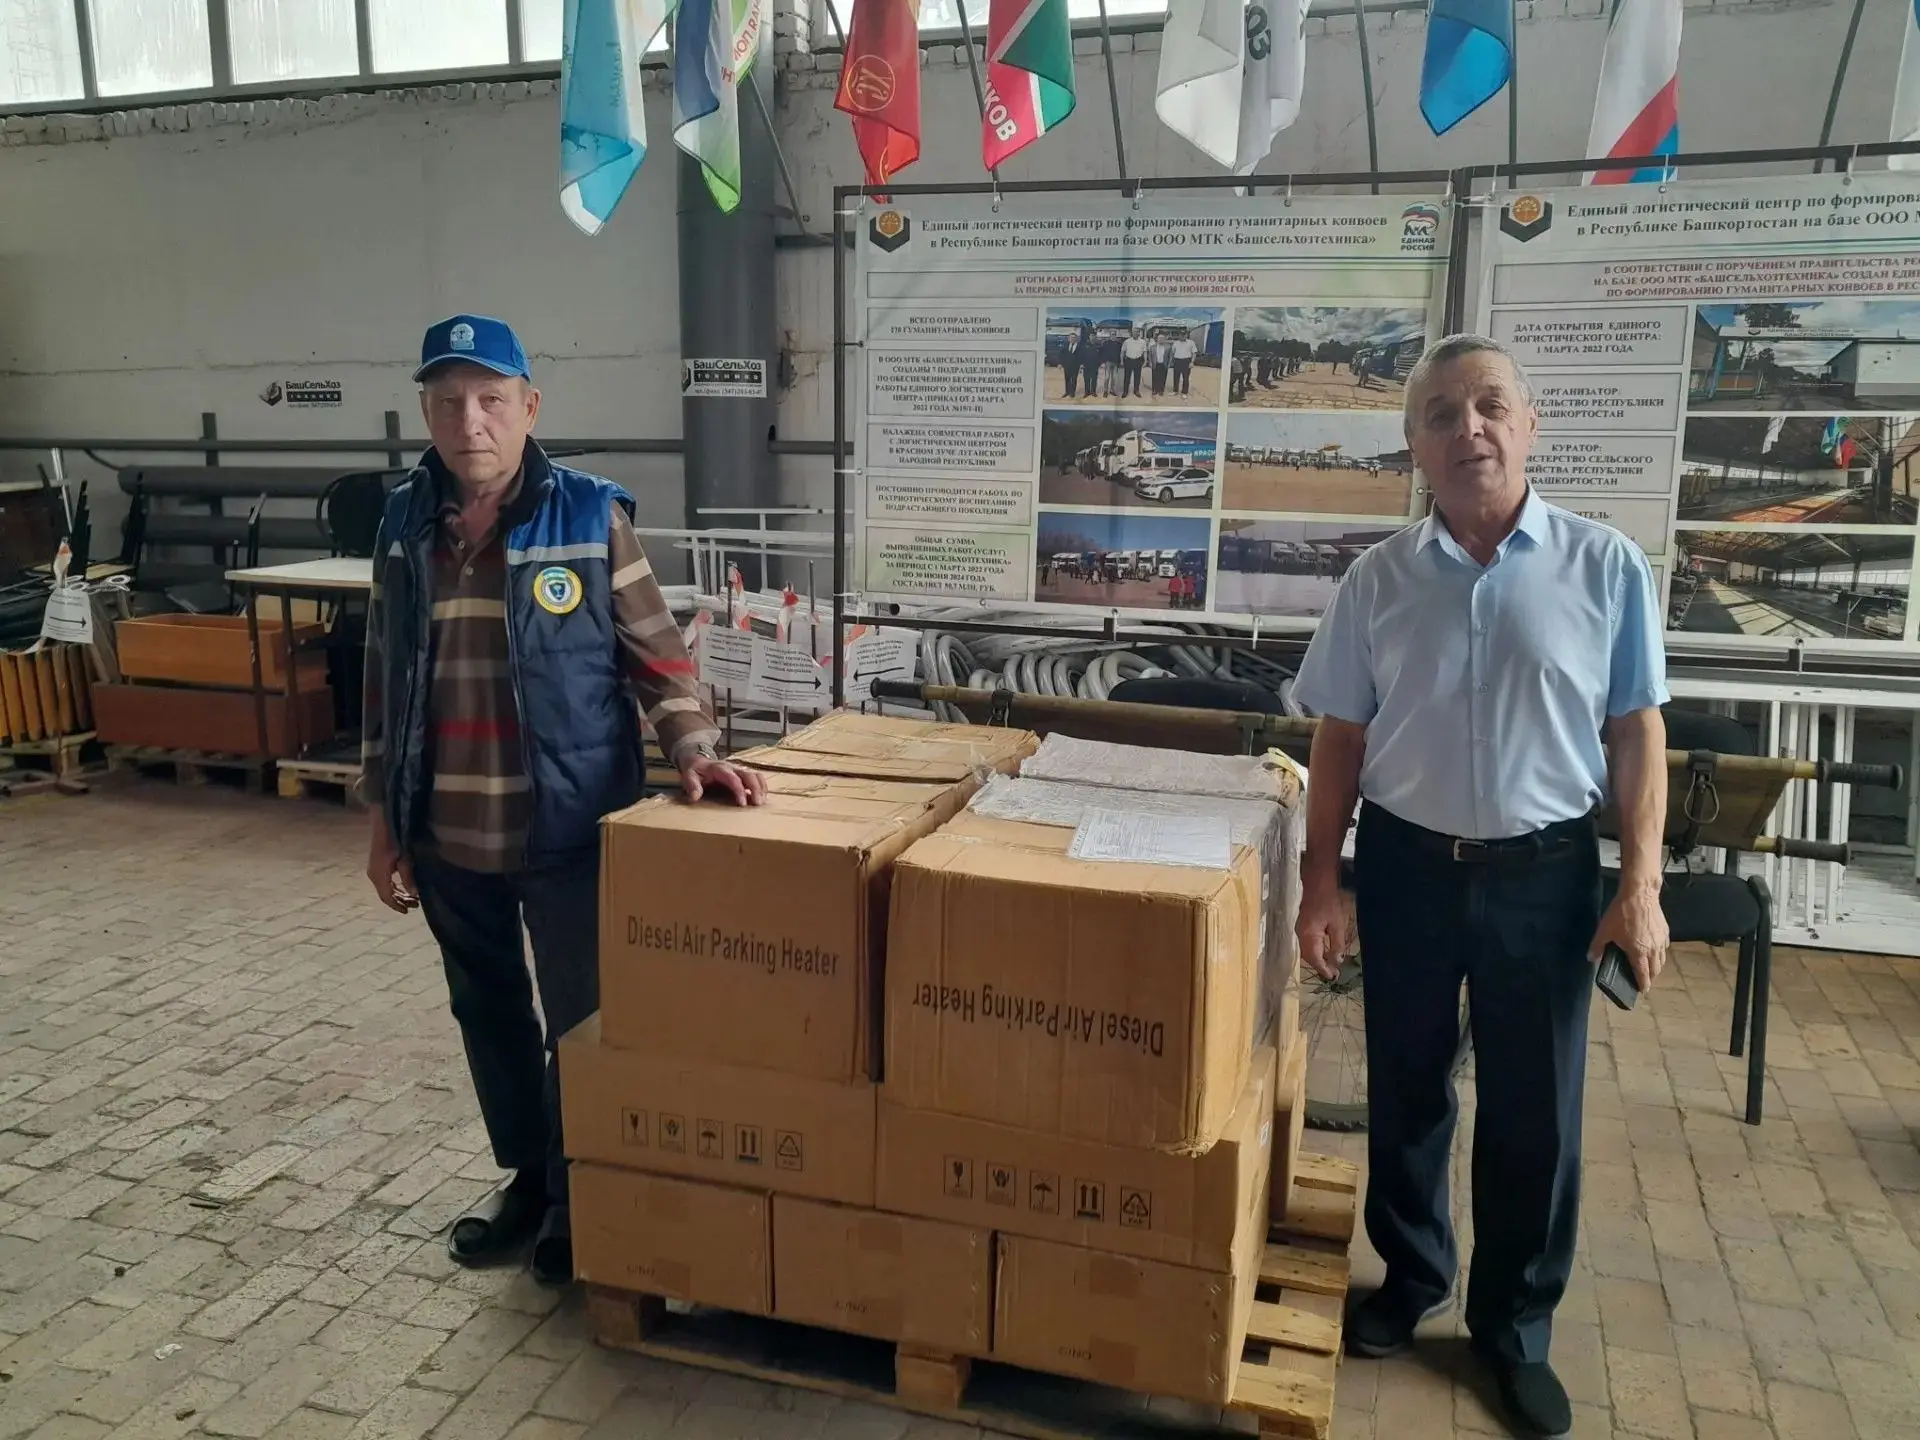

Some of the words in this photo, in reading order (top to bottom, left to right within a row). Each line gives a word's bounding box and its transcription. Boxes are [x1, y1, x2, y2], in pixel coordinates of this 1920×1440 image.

[1567, 203, 1628, 218] Единый
[1632, 198, 1750, 214] логистический
[1755, 198, 1801, 211] центр
[1807, 197, 1825, 208] по
[922, 219, 968, 231] Единый
[972, 217, 1062, 230] логистический
[1066, 219, 1103, 231] центр
[1106, 218, 1121, 228] по
[1124, 217, 1225, 230] формированию
[1229, 216, 1327, 229] гуманитарных
[1332, 216, 1388, 226] конвоев
[1577, 226, 1585, 236] в
[1591, 221, 1678, 237] Республике
[1683, 217, 1798, 232] Башкортостан
[1803, 216, 1822, 228] на
[1827, 213, 1861, 226] базе
[1865, 211, 1909, 224] ООО
[930, 240, 937, 248] в
[941, 236, 1008, 250] Республике
[1012, 235, 1100, 249] Башкортостан
[1104, 236, 1119, 246] на
[1123, 234, 1149, 245] базе
[1152, 233, 1186, 245] ООО
[1189, 233, 1224, 245] МТК
[1227, 233, 1376, 246] «Башсельхозтехника»
[1604, 266, 1611, 274] В
[1614, 263, 1702, 274] СООТВЕТСТВИИ
[1705, 263, 1713, 271] С
[1716, 260, 1796, 271] ПОРУЧЕНИЕМ
[1799, 258, 1899, 269] ПРАВИТЕЛЬСТВА
[1903, 257, 1920, 266] РЕ
[1047, 275, 1081, 283] РАБОТЫ
[1084, 275, 1127, 283] ЕДИНОГО
[1129, 275, 1216, 283] ЛОГИСТИЧЕСКОГО
[1594, 277, 1608, 286] НА
[1611, 276, 1638, 285] БАЗЕ
[1640, 276, 1665, 284] ООО
[1668, 275, 1692, 284] МТК
[1842, 270, 1889, 279] СОЗДАН
[1026, 286, 1060, 294] ПЕРИОД
[1077, 286, 1106, 294] МАРТА
[1607, 289, 1622, 297] ПО
[1625, 286, 1723, 296] ФОРМИРОВАНИЮ
[1726, 284, 1825, 295] ГУМАНИТАРНЫХ
[1828, 282, 1884, 292] КОНВОЕВ
[1514, 323, 1541, 332] ДАТА
[1544, 322, 1603, 332] ОТКРЫТИЯ
[1608, 320, 1661, 330] ЕДИНОГО
[1511, 333, 1612, 343] ЛОГИСТИЧЕСКОГО
[1615, 332, 1662, 342] ЦЕНТРА:
[1544, 345, 1580, 354] МАРТА
[1582, 345, 1602, 353] 2022
[1605, 344, 1634, 353] ГОДА
[693, 360, 761, 370] БашСельХоз
[286, 380, 341, 389] БашСельХоз
[1536, 399, 1590, 407] ТЕЛЬСТВО
[1591, 398, 1664, 407] РЕСПУБЛИКИ
[1537, 410, 1624, 418] БАШКОРТОСТАН
[1551, 444, 1602, 453] КУРАТОР:
[1526, 455, 1586, 463] ИСТЕРСТВО
[1588, 456, 1653, 464] СЕЛЬСКОГО
[1525, 466, 1569, 474] ЯЙСТВА
[1572, 466, 1643, 475] РЕСПУБЛИКИ
[1531, 477, 1618, 485] БАШКОРТОСТАН
[627, 915, 678, 951] Diesel
[682, 925, 707, 956] Air
[711, 928, 776, 974] Parking
[781, 938, 840, 977] Heater
[912, 983, 975, 1023] Heater
[982, 984, 1059, 1037] Parking
[1064, 1005, 1096, 1043] Air
[1100, 1012, 1164, 1057] Diesel
